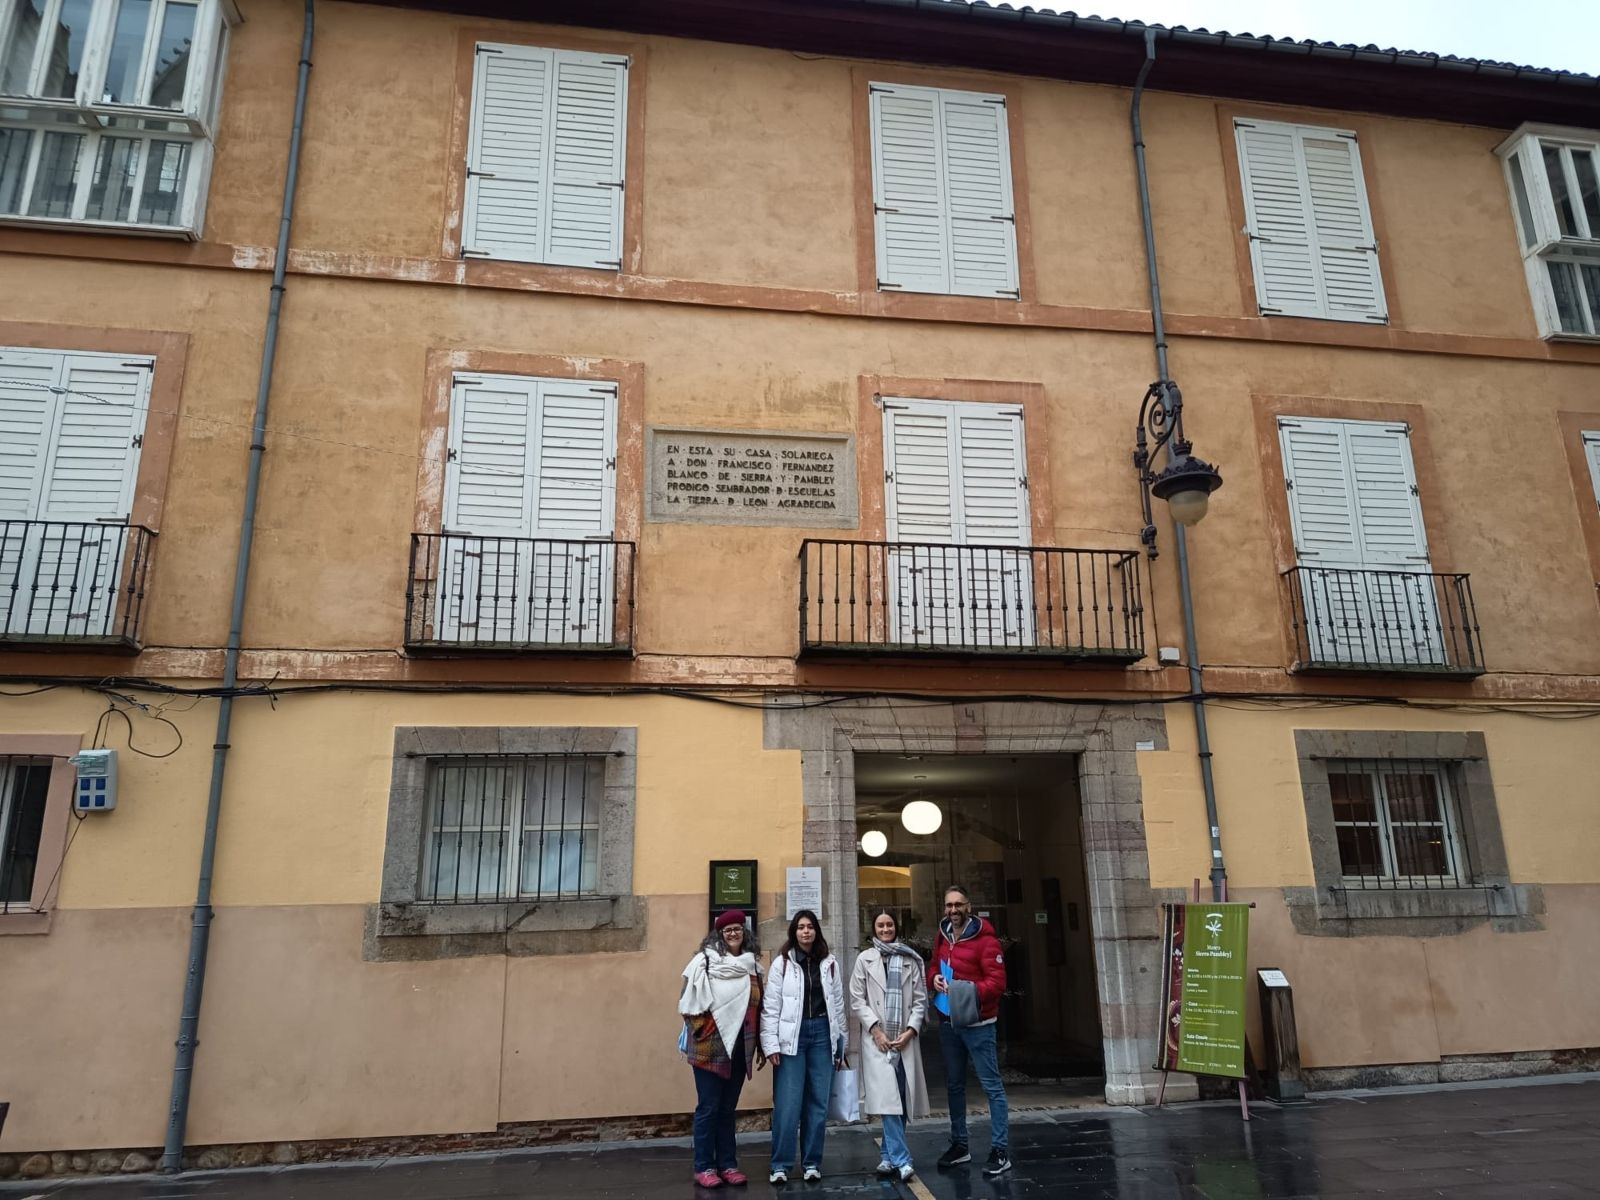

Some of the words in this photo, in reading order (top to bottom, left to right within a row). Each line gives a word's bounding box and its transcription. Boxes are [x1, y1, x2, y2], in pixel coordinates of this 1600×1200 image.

[667, 445, 680, 454] EN
[689, 446, 713, 456] ESTA
[723, 447, 736, 456] SU
[745, 448, 772, 458] CASA
[667, 457, 675, 466] A
[687, 458, 707, 468] DON
[717, 459, 772, 470] FRANCISCO
[782, 462, 835, 473] FERNANDEZ
[667, 469, 708, 479] BLANCO
[718, 472, 730, 481] DE
[741, 472, 772, 482] SIERRA
[780, 474, 786, 483] Y
[793, 474, 835, 485] PAMBLEY
[667, 482, 710, 492] PRODIGO
[715, 484, 770, 494] SEMBRADOR
[788, 487, 836, 497] ESCUELAS
[667, 495, 681, 504] LA
[687, 495, 719, 505] TIERRA
[743, 497, 768, 507] LEON
[777, 499, 836, 509] AGRADECIDA
[964, 707, 975, 723] 4
